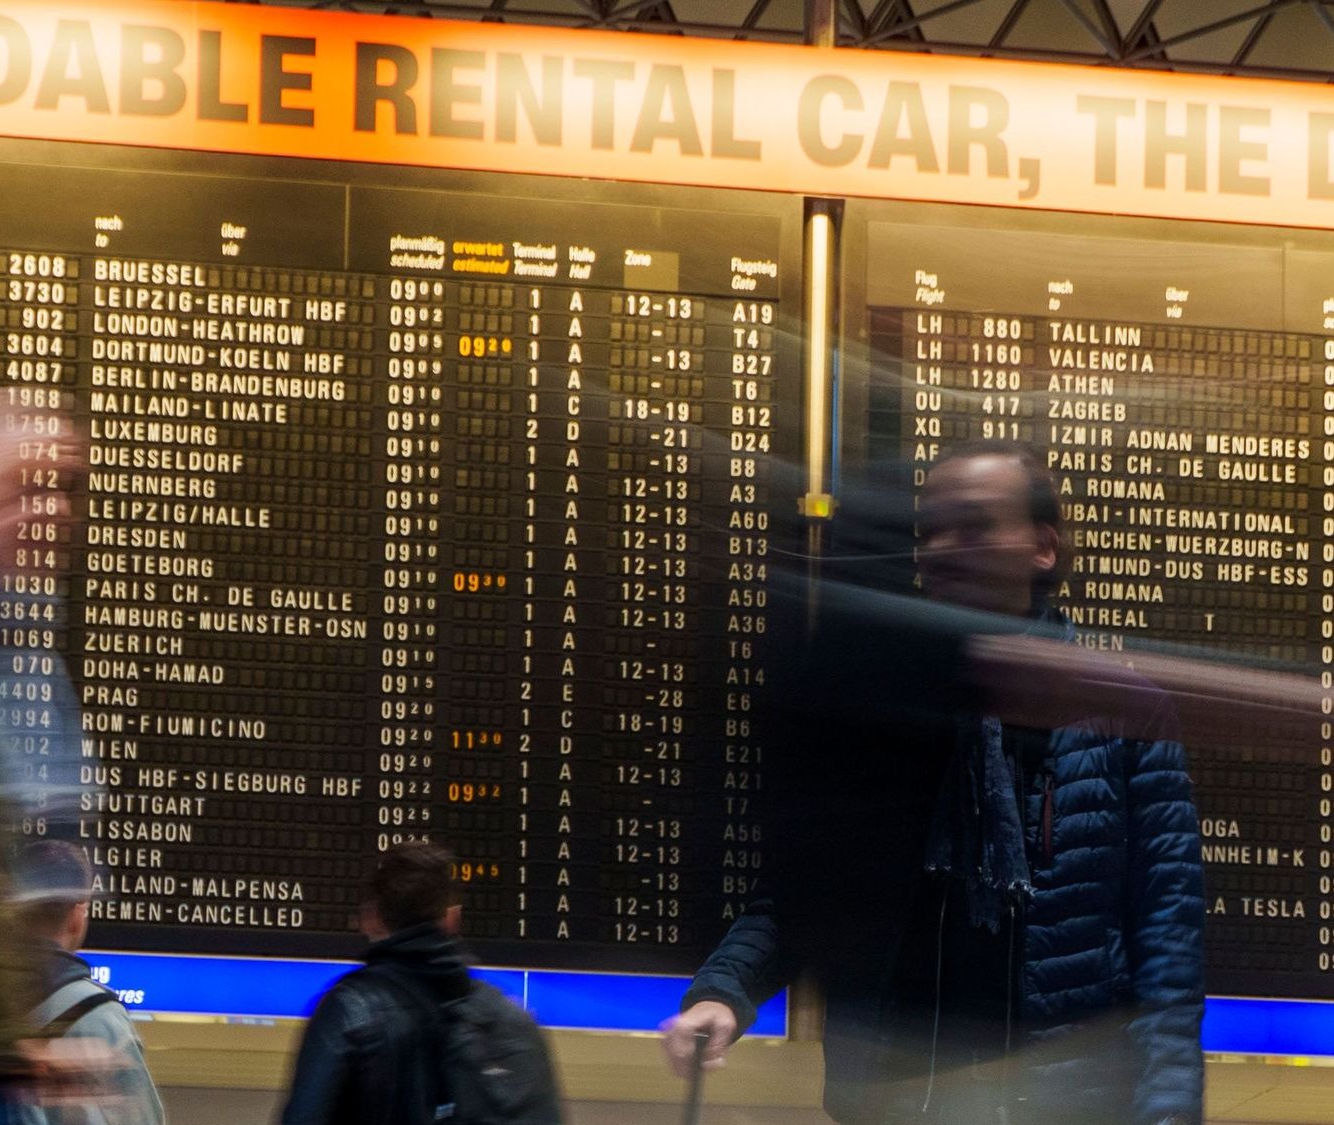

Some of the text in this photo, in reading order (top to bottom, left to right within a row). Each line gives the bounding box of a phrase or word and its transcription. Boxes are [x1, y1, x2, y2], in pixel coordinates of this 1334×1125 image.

[354, 41, 761, 161] RENTAL
[797, 74, 1041, 200] CAR,
[1076, 95, 1271, 197] THE
[10, 254, 64, 277] 2608
[95, 260, 204, 286] BRUESSEL
[391, 280, 442, 300] 0900
[531, 289, 540, 309] 1
[569, 291, 583, 312] A
[628, 295, 691, 318] 12-13
[733, 303, 772, 323] A19
[10, 281, 63, 303] 3730
[95, 286, 290, 320] LEIPZIG-ERFURT
[306, 301, 345, 321] HBF
[23, 308, 303, 347] 902 LONDON-HEATHROW
[918, 315, 941, 333] LH
[984, 319, 1020, 339] 880
[1050, 323, 1140, 346] TALLINN
[973, 344, 1153, 372] 1160 VALENCIA
[7, 361, 61, 382] 4087
[91, 364, 344, 403] BERLIN-BRANDENBURG
[972, 370, 1113, 395] 1280 ATHEN
[8, 388, 59, 408] 1968
[91, 393, 285, 426] MAILAND-LINATE
[916, 392, 1125, 421] OU 417 ZAGREB
[91, 420, 216, 445] LUXEMBURG
[916, 418, 1309, 458] XQ 911 IZMIR ADNAN MENDERES
[90, 446, 242, 472] DUESSELDORF
[1048, 451, 1295, 483] PARIS CH. DE GAULLE
[90, 473, 214, 498] NUERNBERG
[1088, 479, 1164, 500] ROMANA
[89, 499, 269, 530] LEIPZIG/HALLE
[88, 526, 185, 548] DRESDEN
[88, 553, 212, 577] GOETEBORG
[85, 633, 181, 655] ZUERICH
[84, 660, 223, 683] DOHA-HAMAD
[84, 686, 137, 706] PRAG
[83, 713, 264, 739] ROM-FIUMICINO
[81, 739, 136, 758] WIEN
[79, 791, 204, 815] STUTTGART
[81, 820, 190, 841] LISSABON
